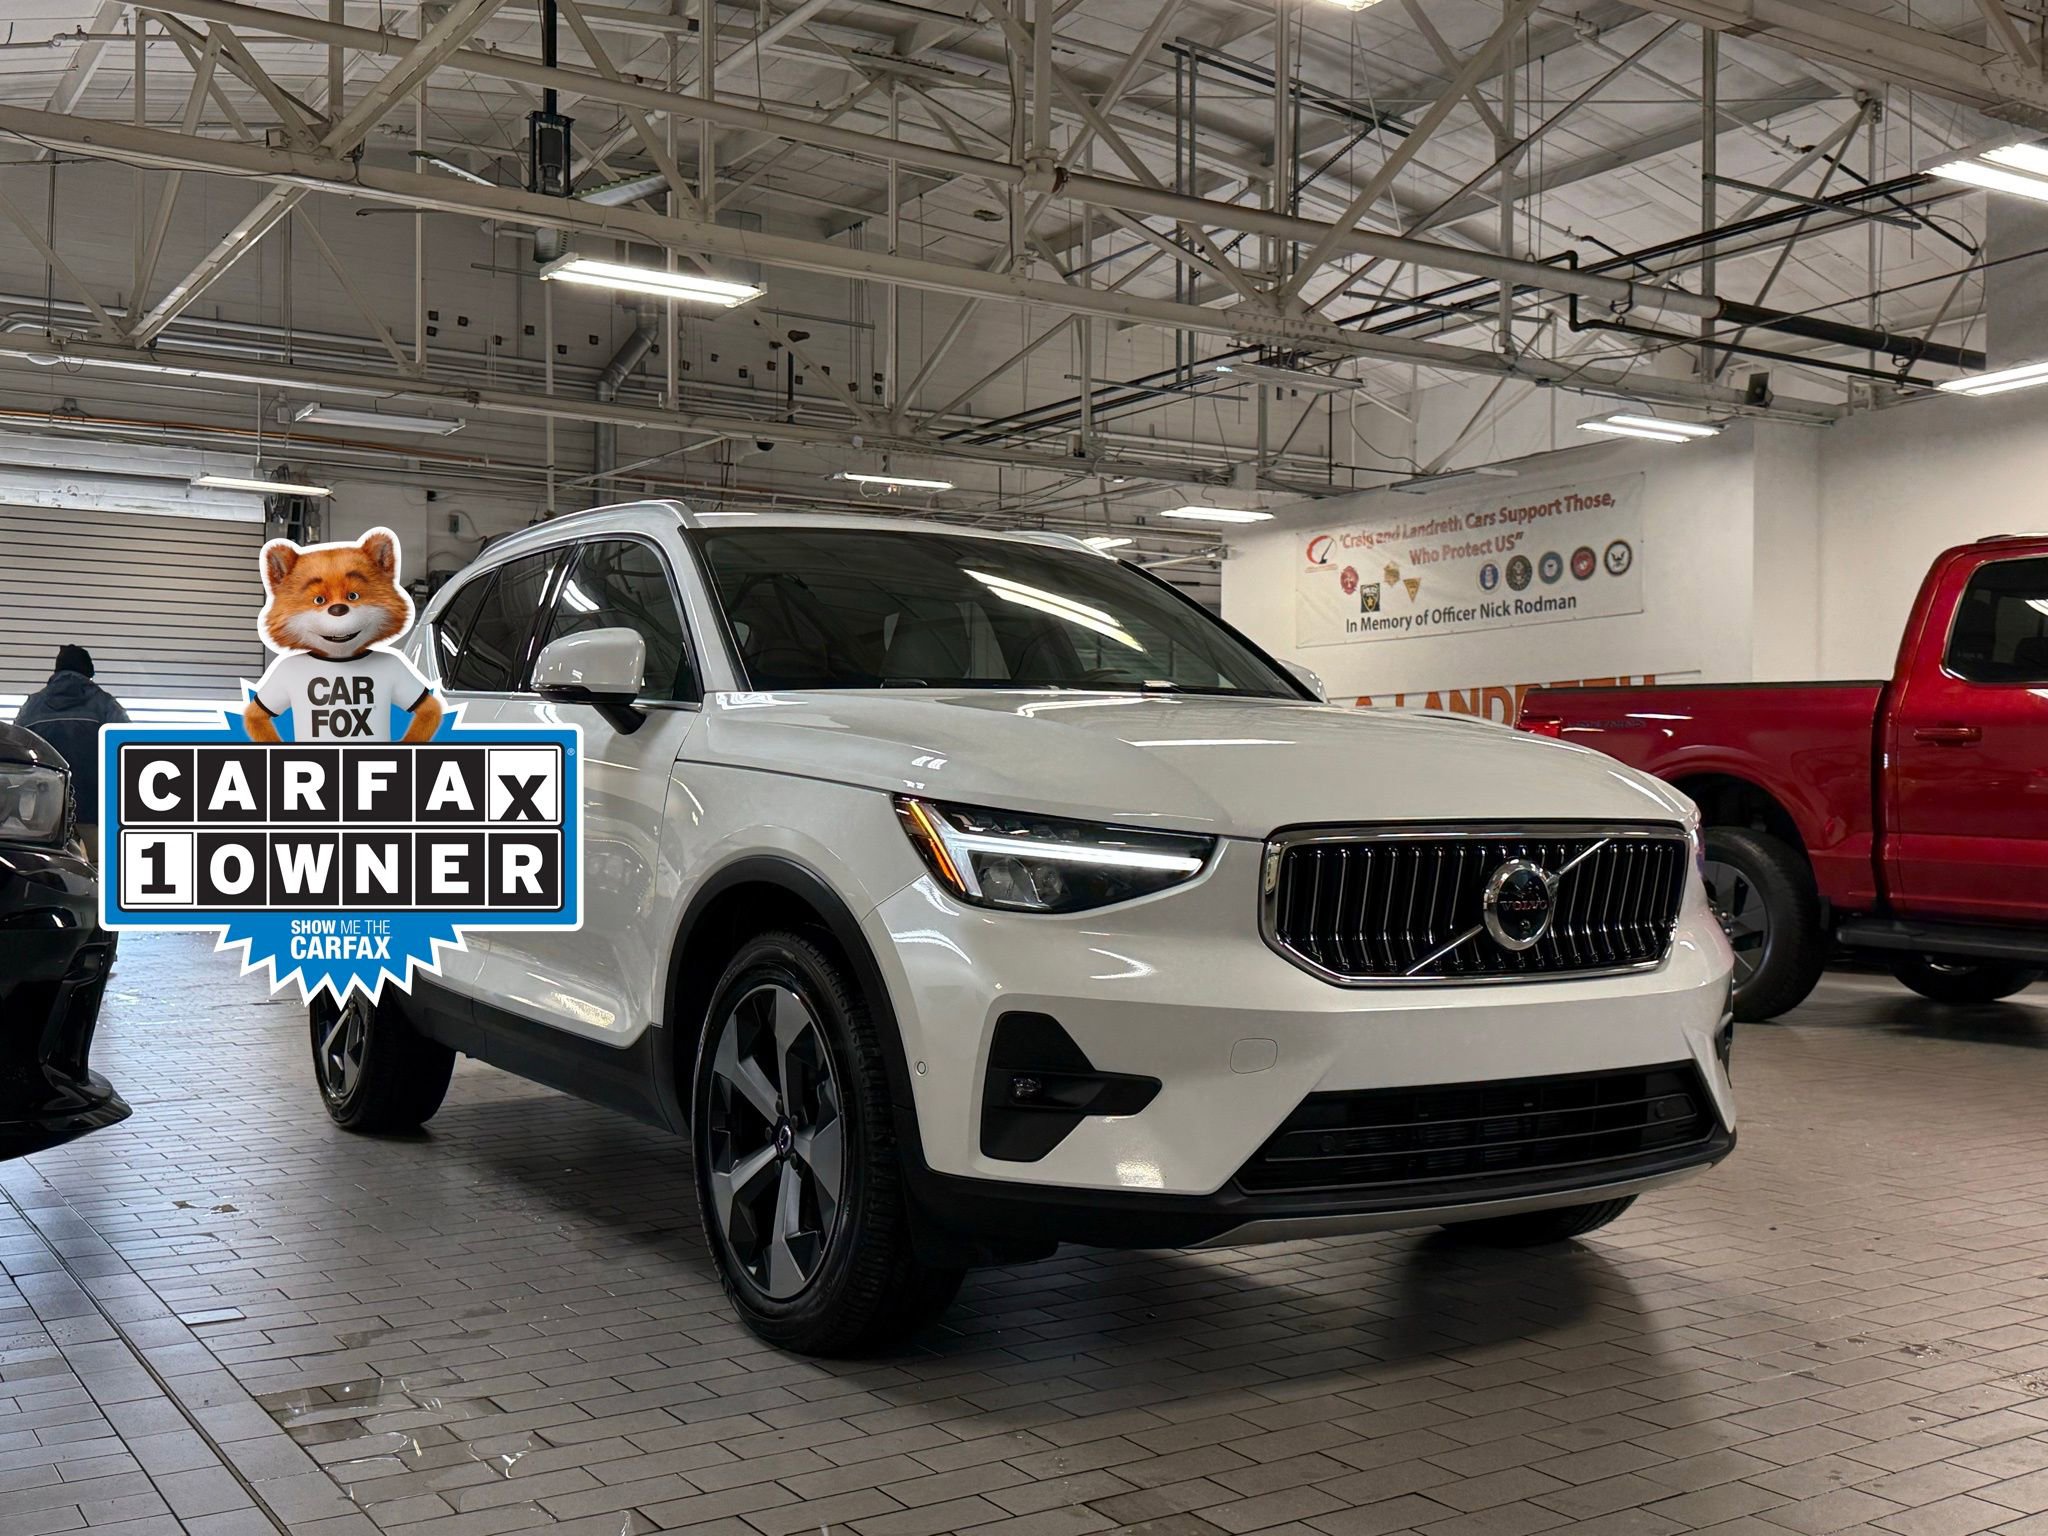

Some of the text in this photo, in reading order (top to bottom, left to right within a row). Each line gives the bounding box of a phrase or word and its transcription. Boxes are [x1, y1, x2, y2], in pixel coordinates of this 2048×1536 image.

[1402, 515, 1463, 540] Landreth
[1465, 511, 1496, 530] Cars
[1499, 498, 1562, 525] Support
[1563, 492, 1616, 514] Those,
[1409, 546, 1440, 566] Who
[1441, 536, 1493, 562] Protect
[1346, 595, 1577, 634] In Memory of Officer Nick Rodman
